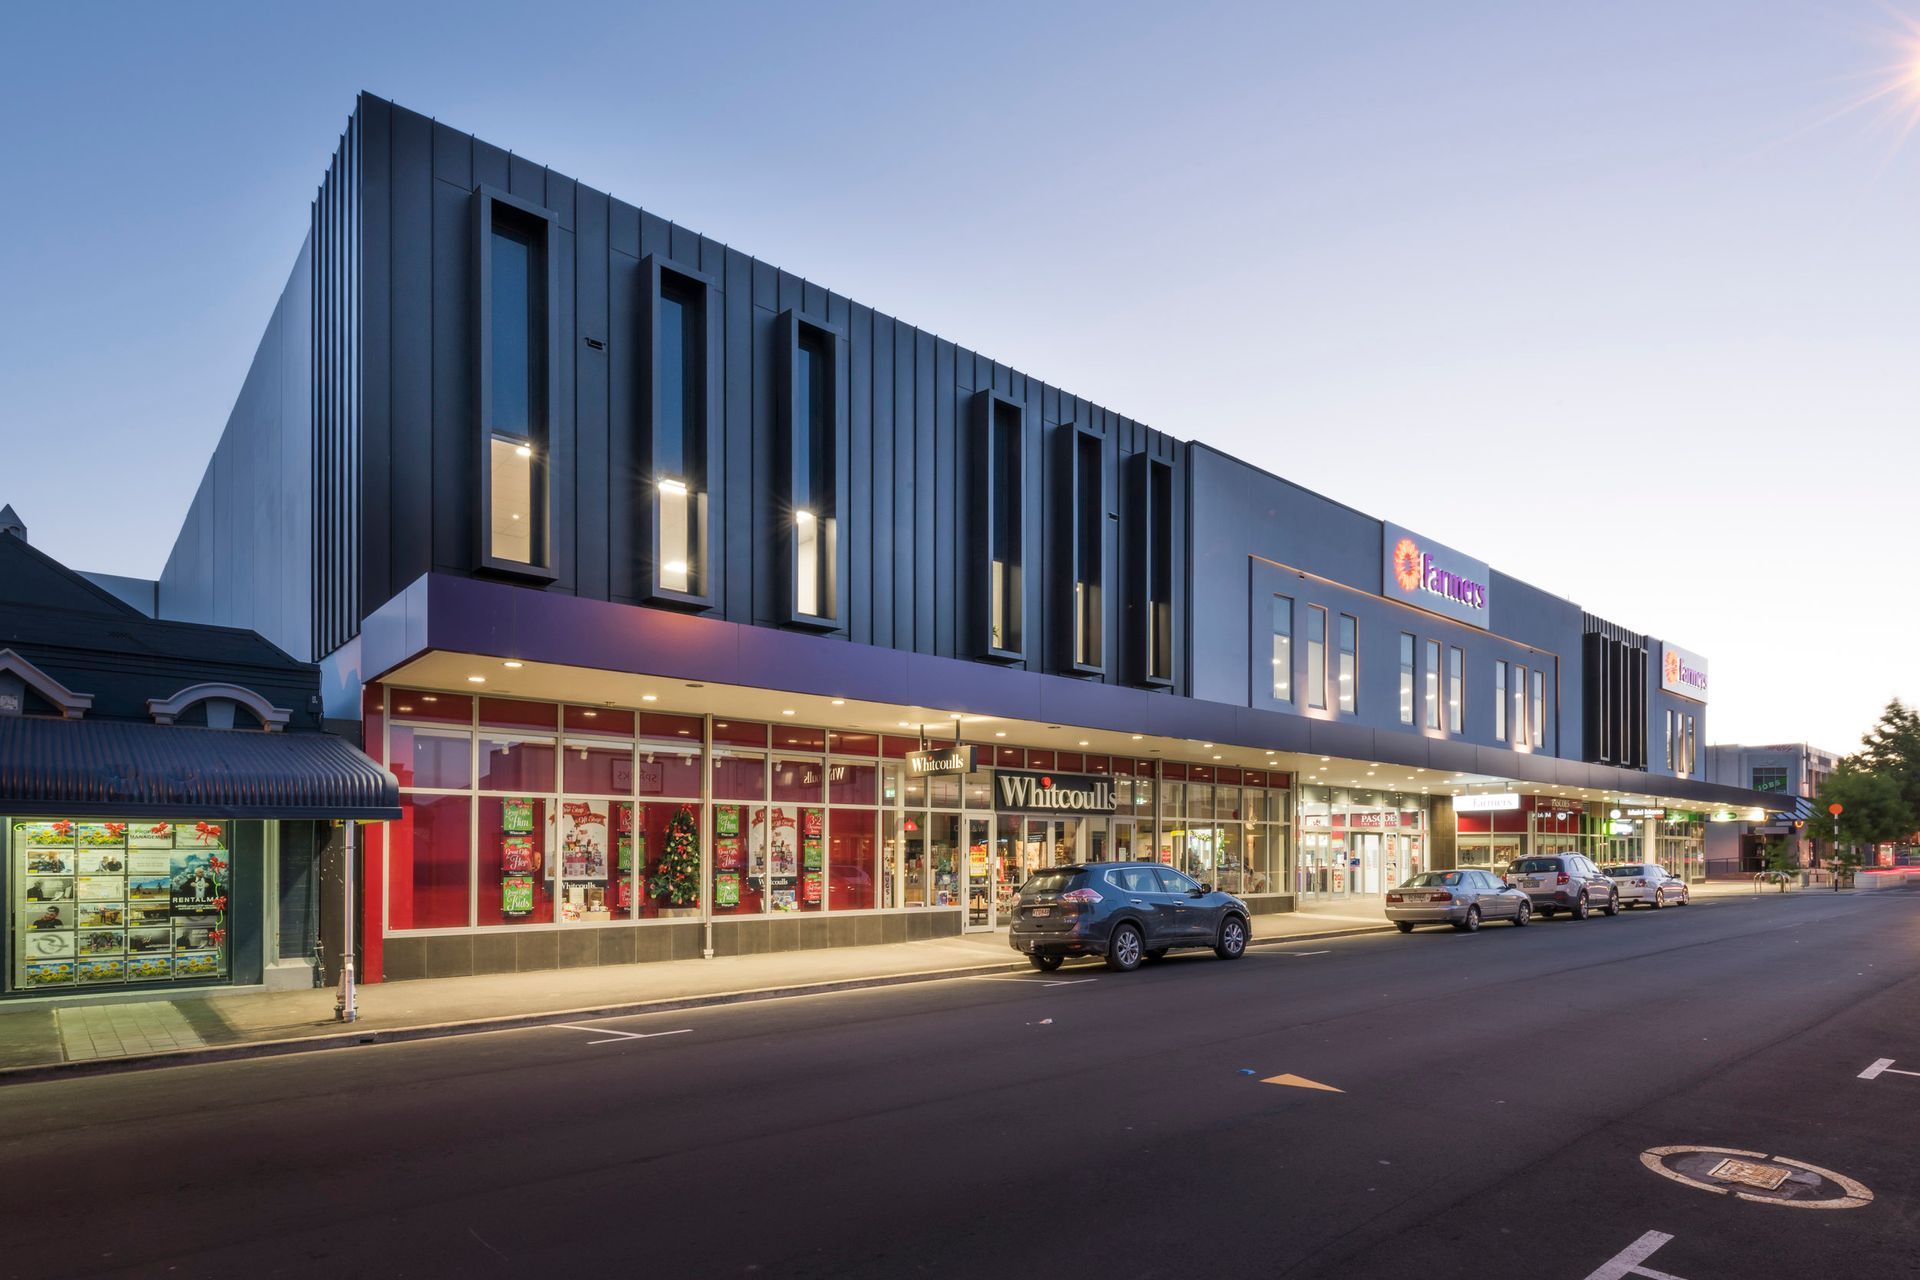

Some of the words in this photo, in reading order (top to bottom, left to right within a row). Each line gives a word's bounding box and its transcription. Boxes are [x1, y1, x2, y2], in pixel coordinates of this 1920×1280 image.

[1420, 553, 1486, 609] Farmers
[1678, 658, 1707, 690] Farmers
[912, 753, 964, 773] Whitcoulls
[998, 775, 1117, 810] Whitcoulls
[758, 878, 788, 886] Wcoulls
[172, 896, 220, 904] RENTALM
